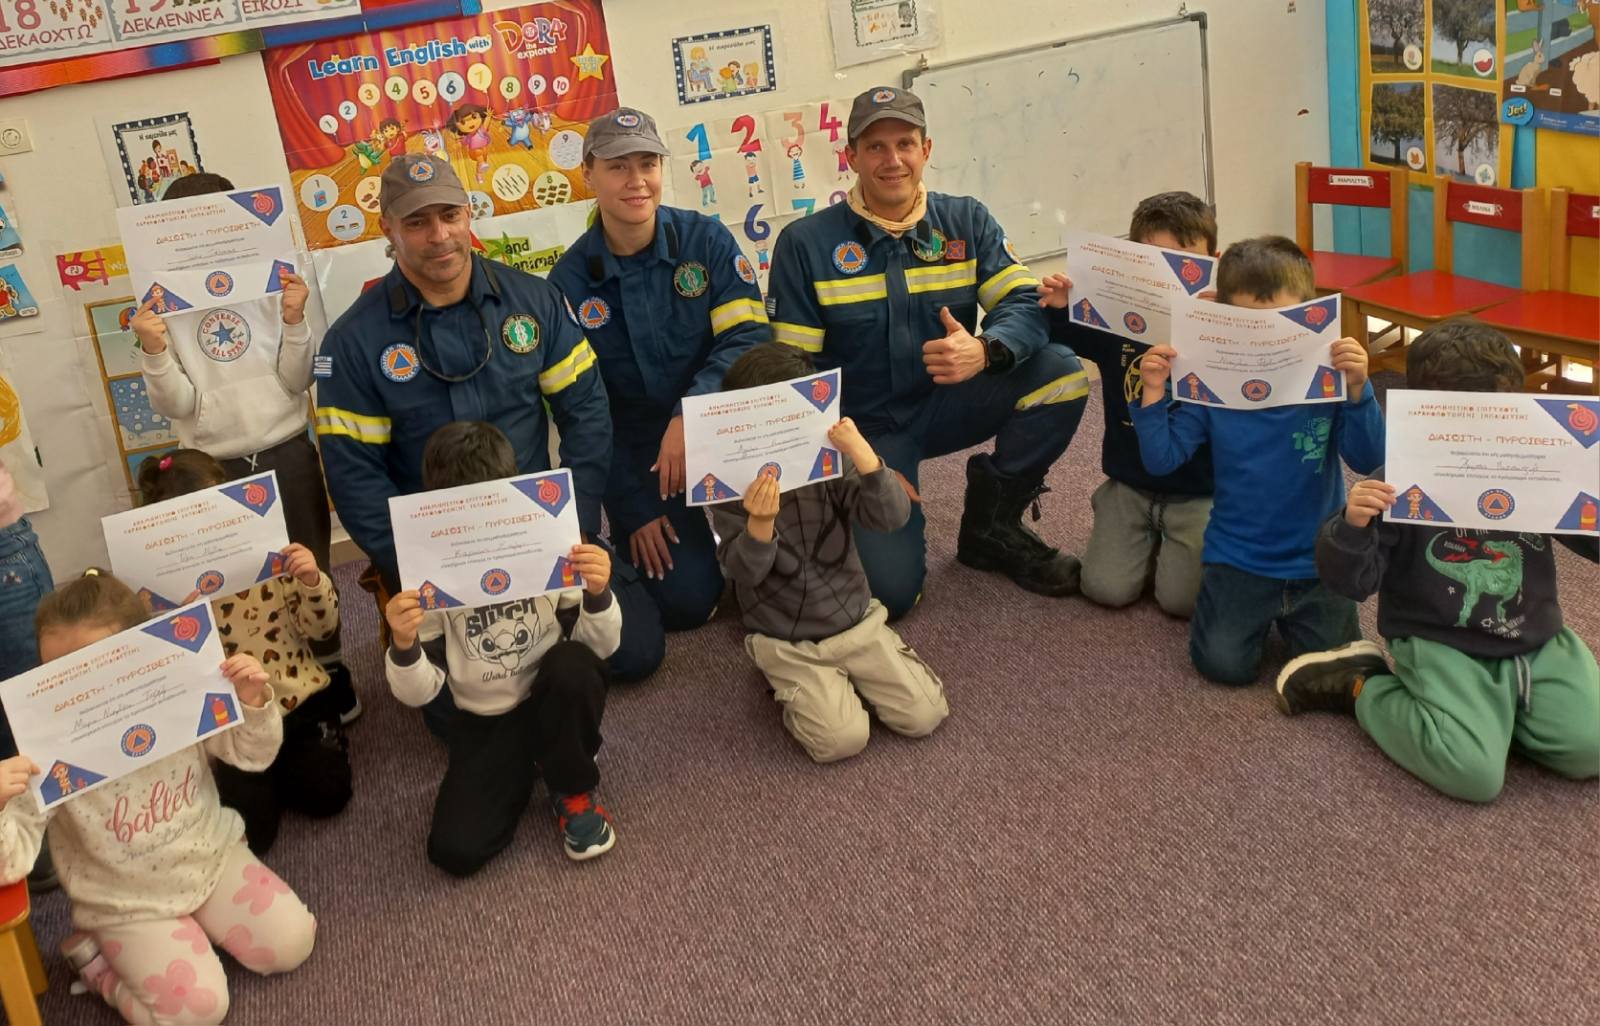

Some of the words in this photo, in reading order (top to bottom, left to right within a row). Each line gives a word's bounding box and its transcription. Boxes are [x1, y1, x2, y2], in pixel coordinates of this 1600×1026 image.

[122, 7, 224, 34] ΔΕΚΑΕΝΝΕΑ
[493, 17, 567, 54] DORA
[308, 54, 379, 80] Learn
[385, 36, 467, 68] English
[468, 38, 490, 50] with
[517, 45, 558, 60] explorer
[391, 83, 401, 95] 4
[446, 80, 456, 95] 6
[506, 82, 514, 92] 8
[534, 80, 541, 89] 9
[557, 80, 567, 91] 10
[364, 88, 375, 100] 3
[420, 86, 430, 100] 5
[344, 105, 352, 115] 2
[686, 123, 712, 160] 1
[731, 115, 762, 153] 2
[781, 112, 805, 149] 3
[820, 103, 842, 142] 4
[744, 204, 771, 241] 6
[505, 240, 530, 254] and
[203, 313, 241, 334] CONVERSE
[211, 347, 226, 357] ALL
[227, 340, 244, 357] STAR
[467, 598, 537, 637] STITCH
[105, 765, 197, 843] ballet
